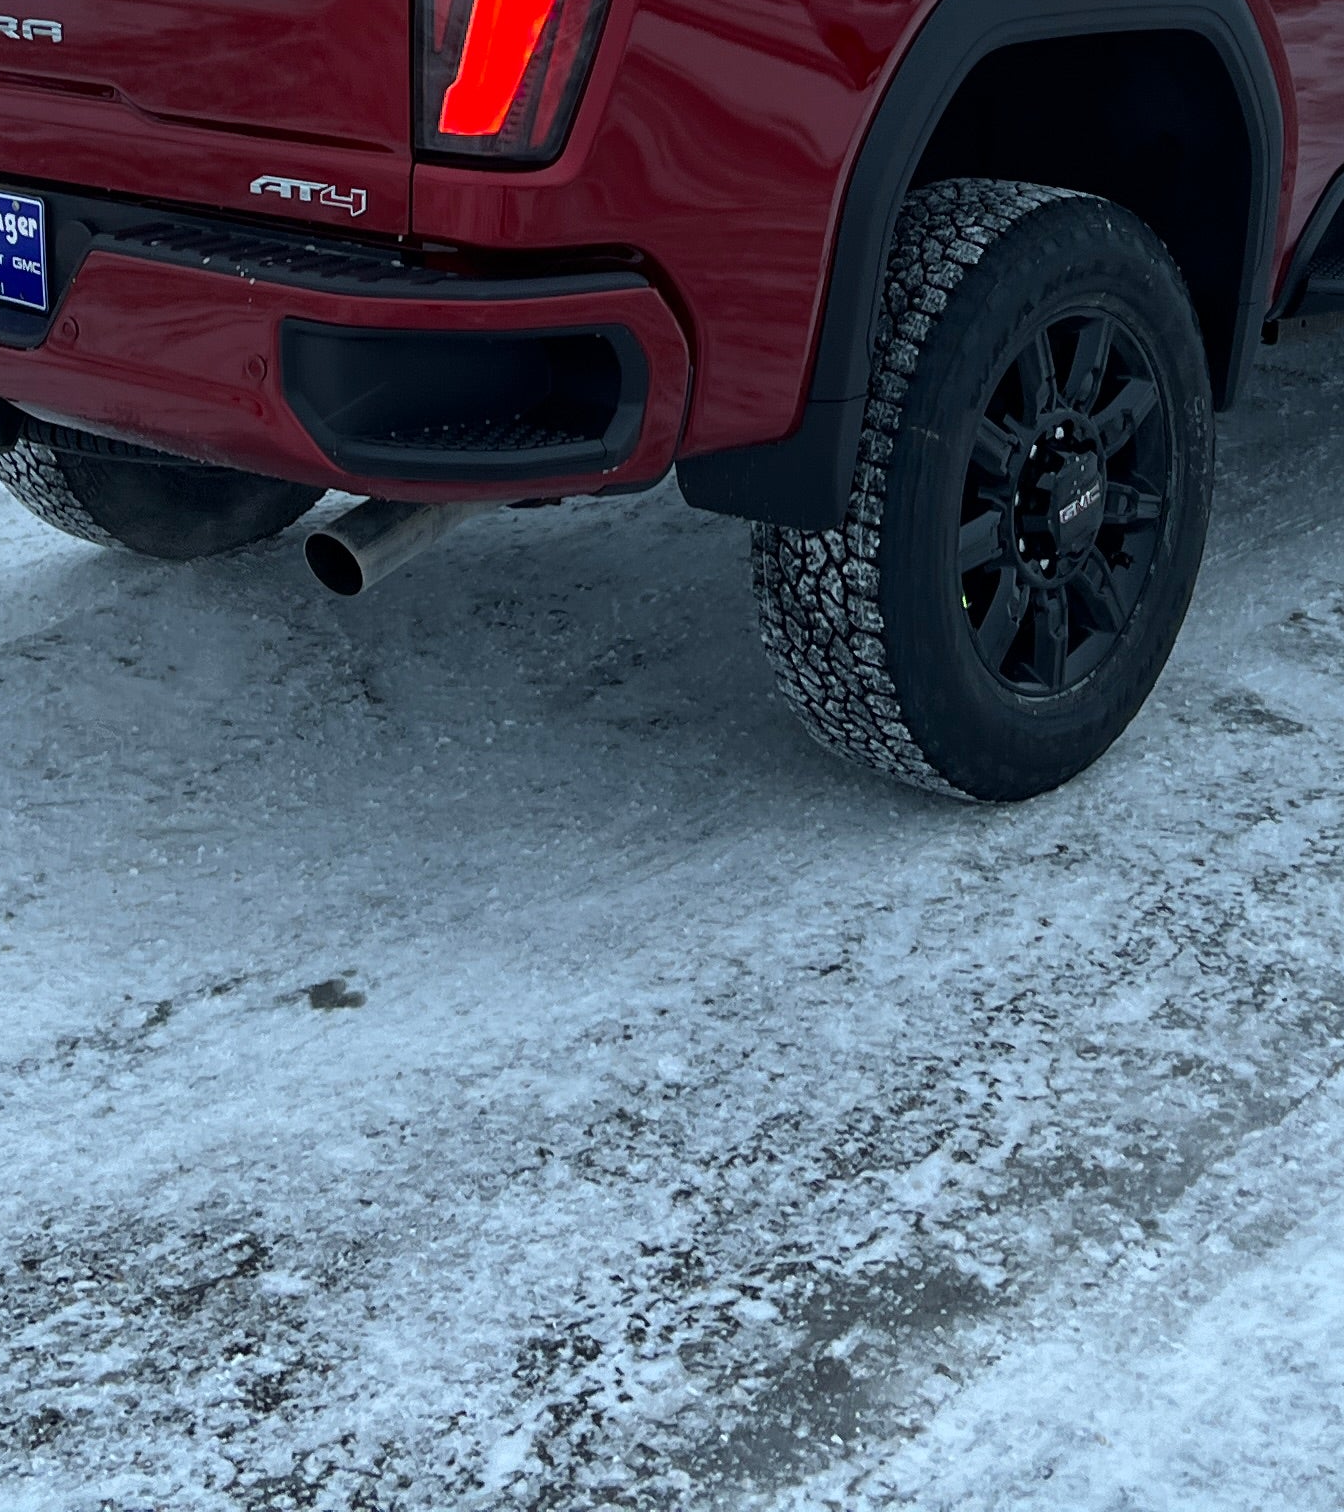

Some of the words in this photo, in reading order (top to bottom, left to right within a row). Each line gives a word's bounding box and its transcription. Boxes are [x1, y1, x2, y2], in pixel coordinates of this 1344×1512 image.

[250, 175, 367, 217] AT4
[12, 256, 42, 275] GMC
[1059, 483, 1101, 524] GMC
